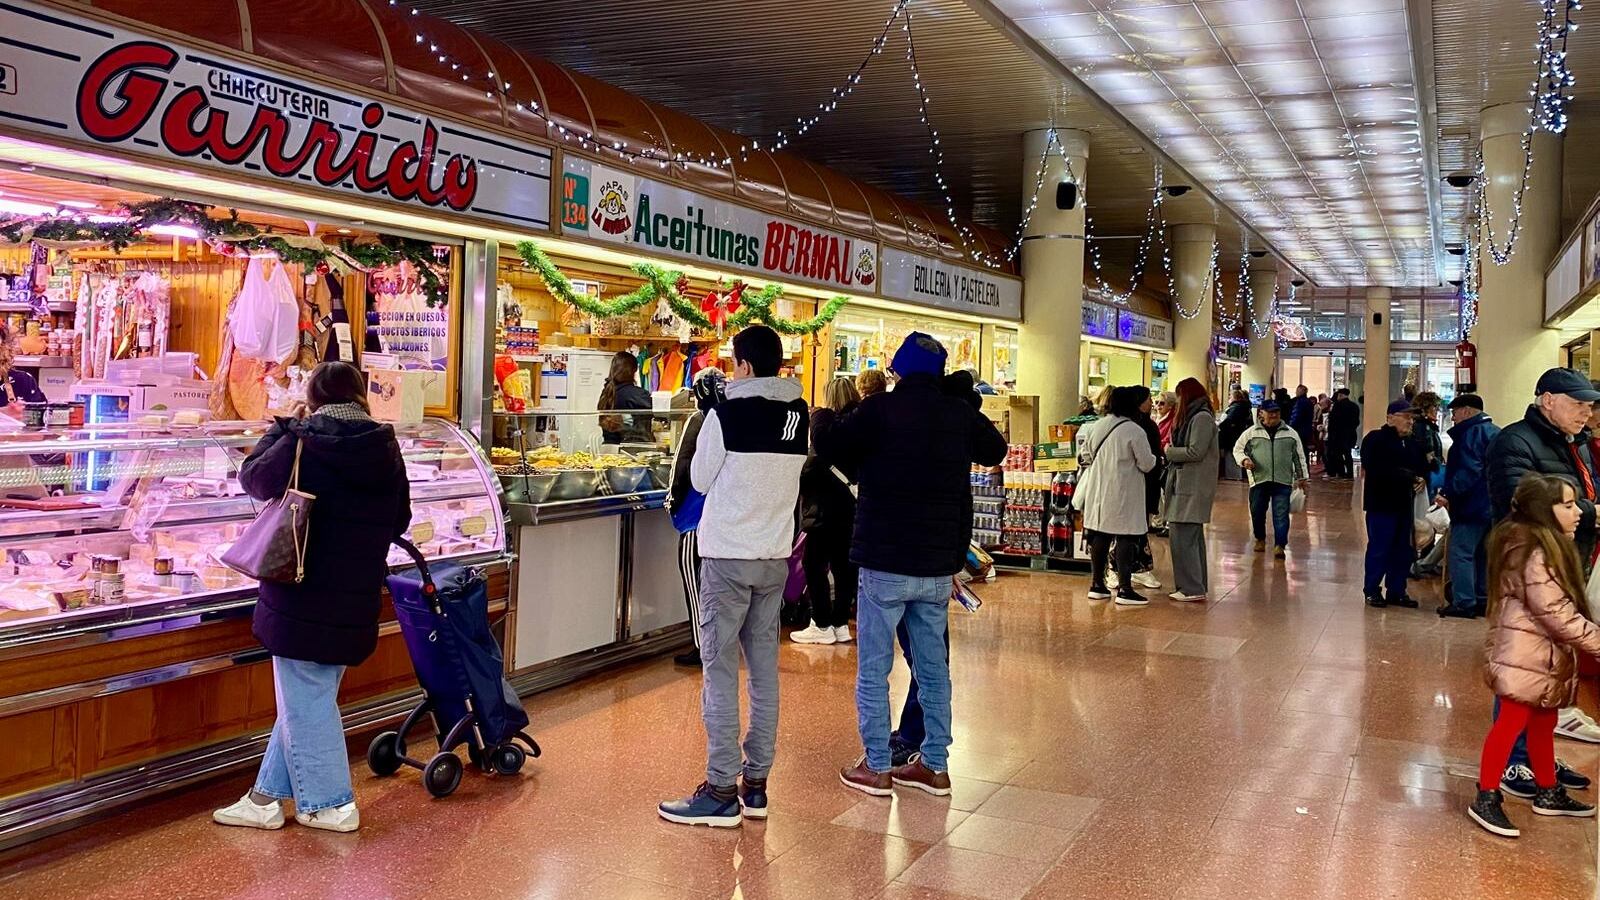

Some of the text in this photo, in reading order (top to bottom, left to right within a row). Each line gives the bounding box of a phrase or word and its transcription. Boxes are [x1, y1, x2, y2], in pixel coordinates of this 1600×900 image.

[207, 69, 329, 118] CHARCUTERIA
[76, 40, 478, 211] Garrido
[563, 201, 586, 226] 134
[633, 193, 853, 285] Aceitunas BERNAL
[914, 265, 1000, 307] BOLLERIA Y PASTELERIA
[411, 327, 446, 337] IBERICOS
